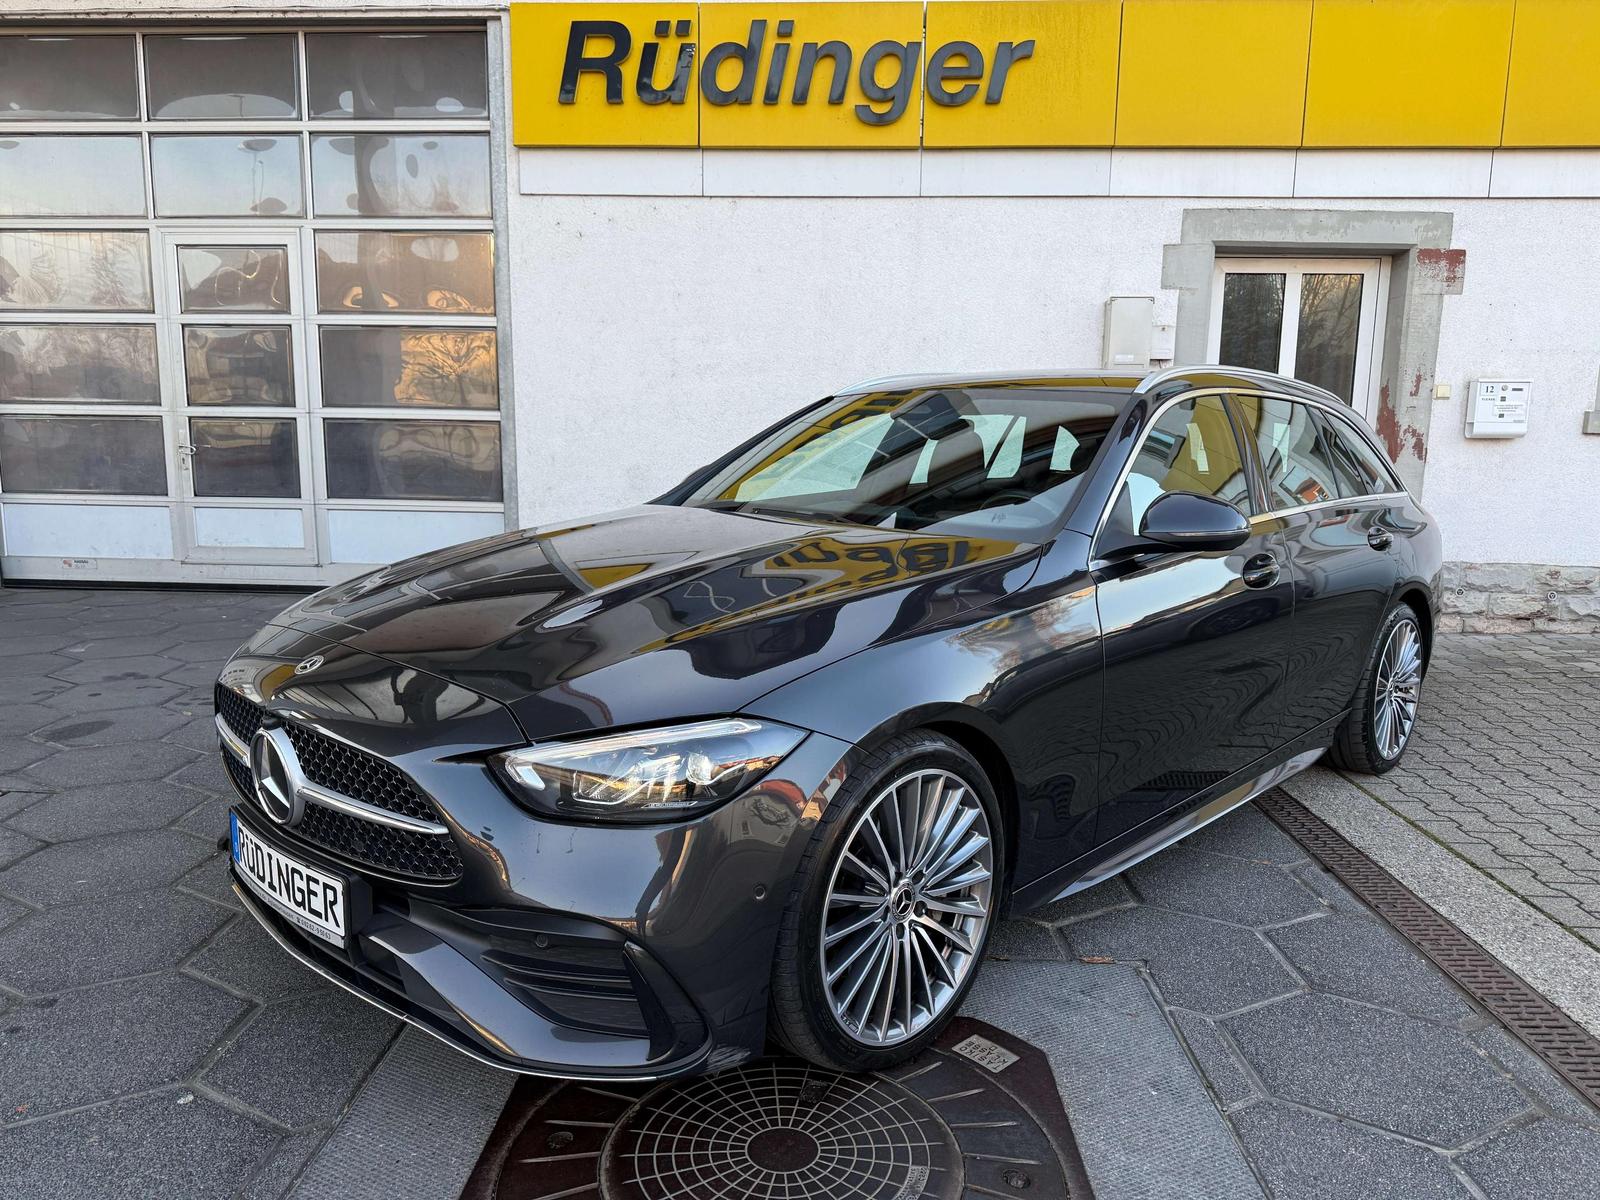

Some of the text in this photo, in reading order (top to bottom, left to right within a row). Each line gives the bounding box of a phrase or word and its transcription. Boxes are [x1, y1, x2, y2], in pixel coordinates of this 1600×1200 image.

[557, 19, 1036, 126] Rüdinger
[1485, 385, 1495, 393] 12
[238, 826, 340, 928] RÜDINGER
[966, 1040, 1008, 1065] KLASSE
